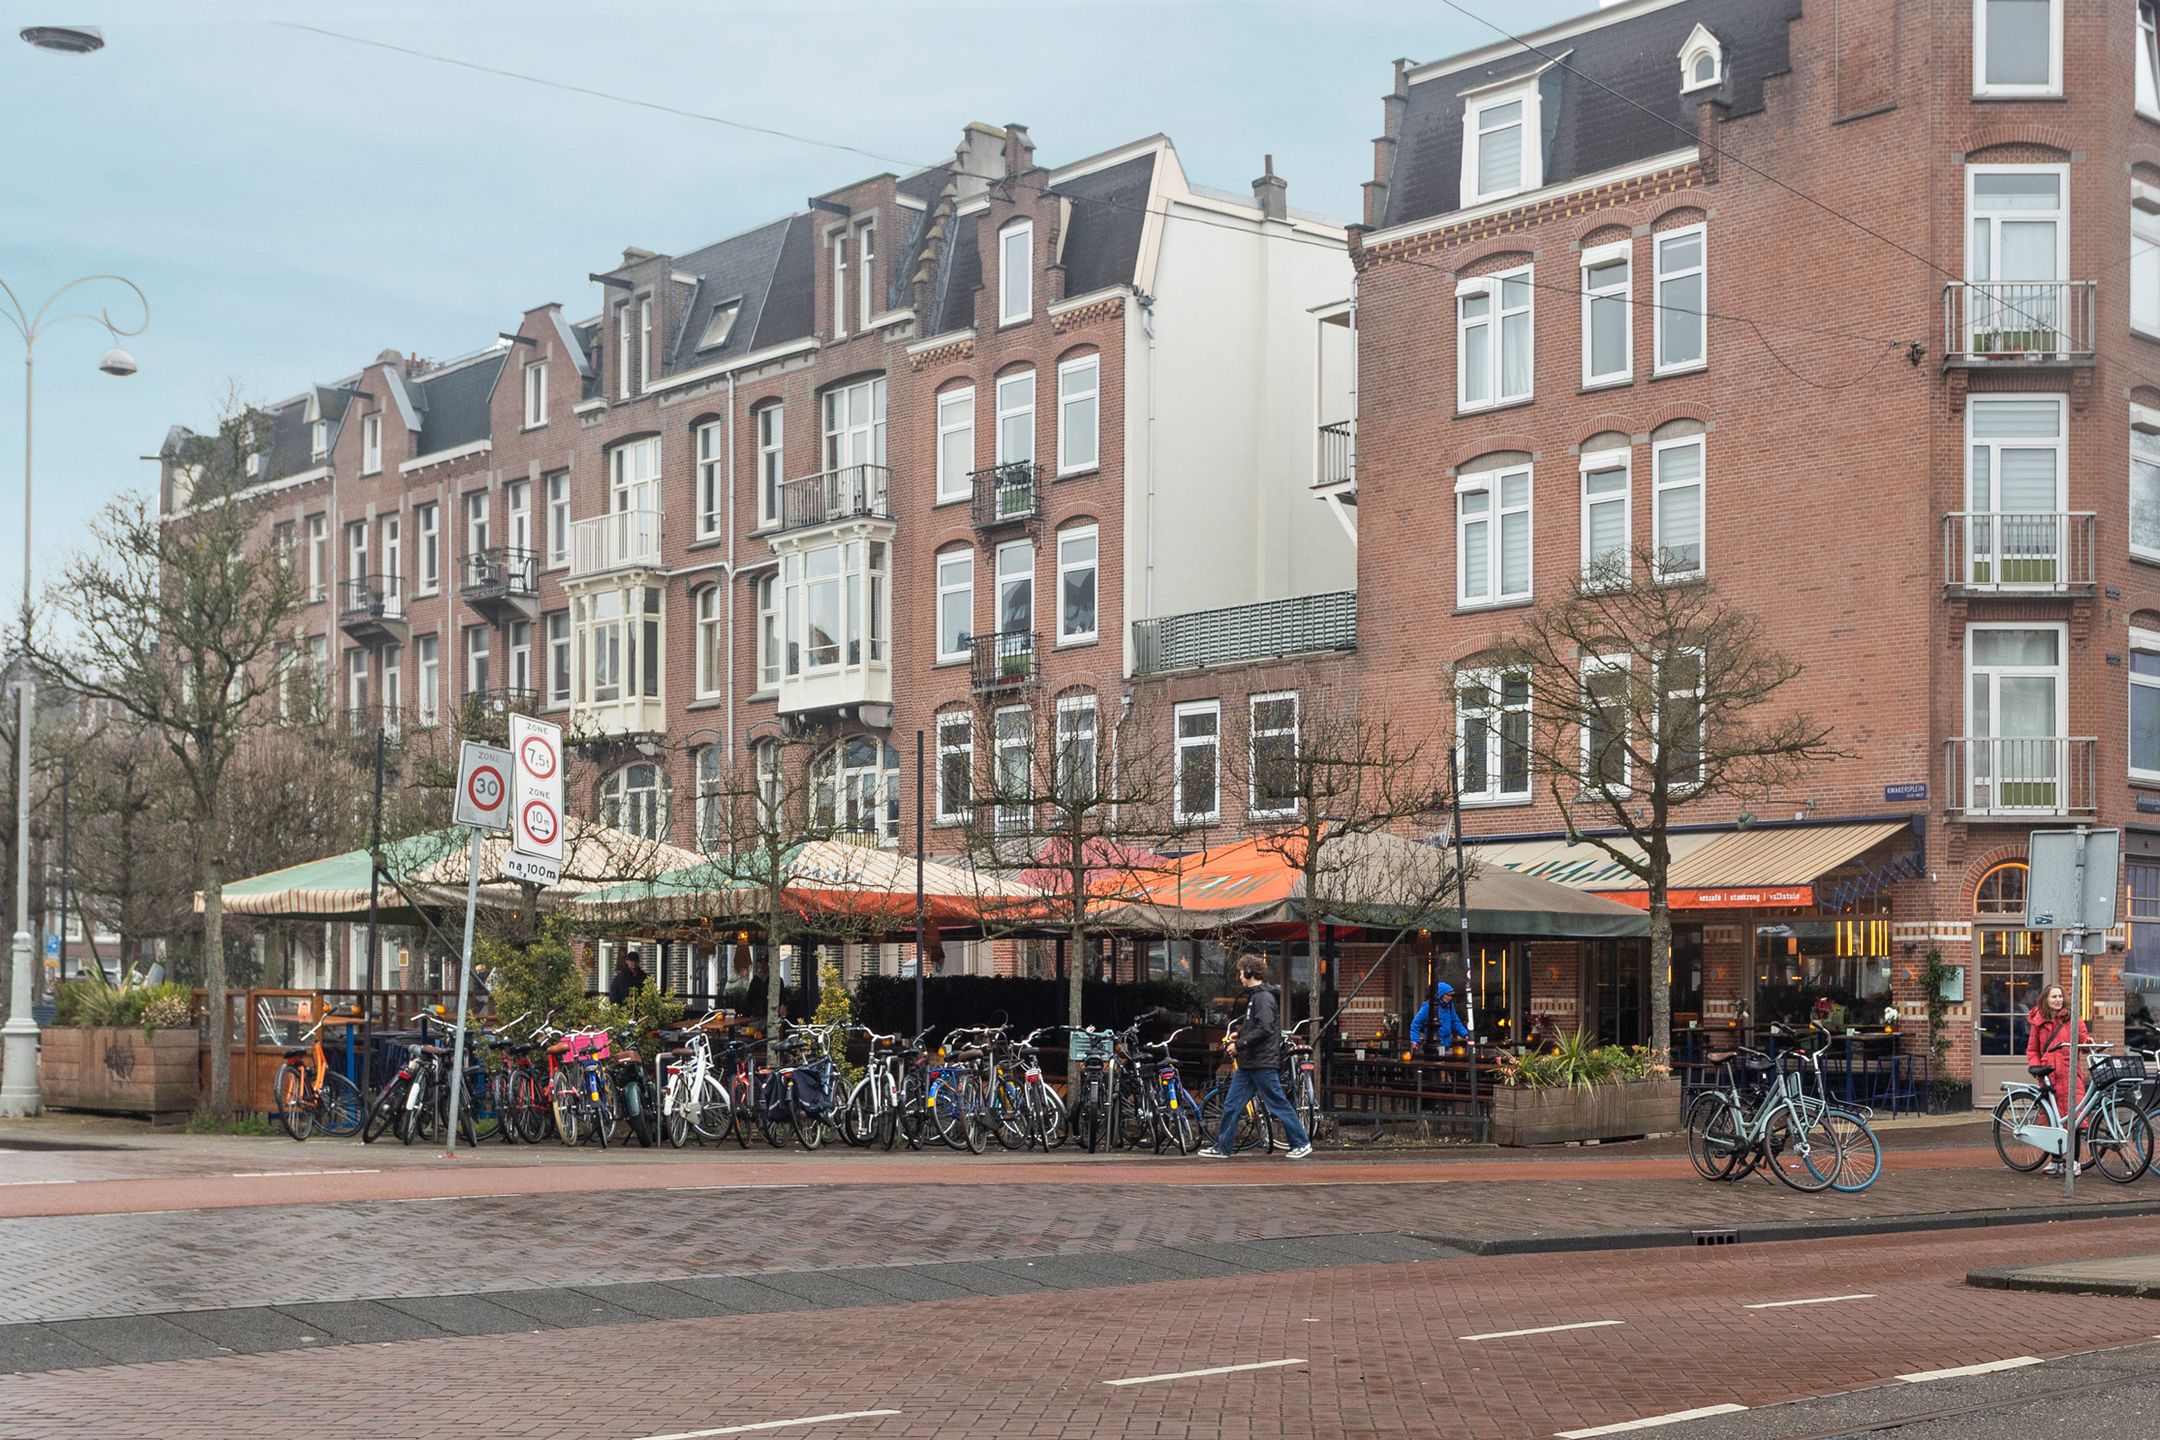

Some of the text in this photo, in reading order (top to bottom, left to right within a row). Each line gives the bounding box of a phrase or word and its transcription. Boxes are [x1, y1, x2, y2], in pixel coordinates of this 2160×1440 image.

[526, 723, 548, 735] ZONE
[478, 751, 501, 763] ZONE
[475, 778, 499, 797] 30
[528, 787, 551, 799] ZONE
[1887, 784, 1925, 795] KWAKERSPLEIN
[508, 860, 556, 880] na 100m
